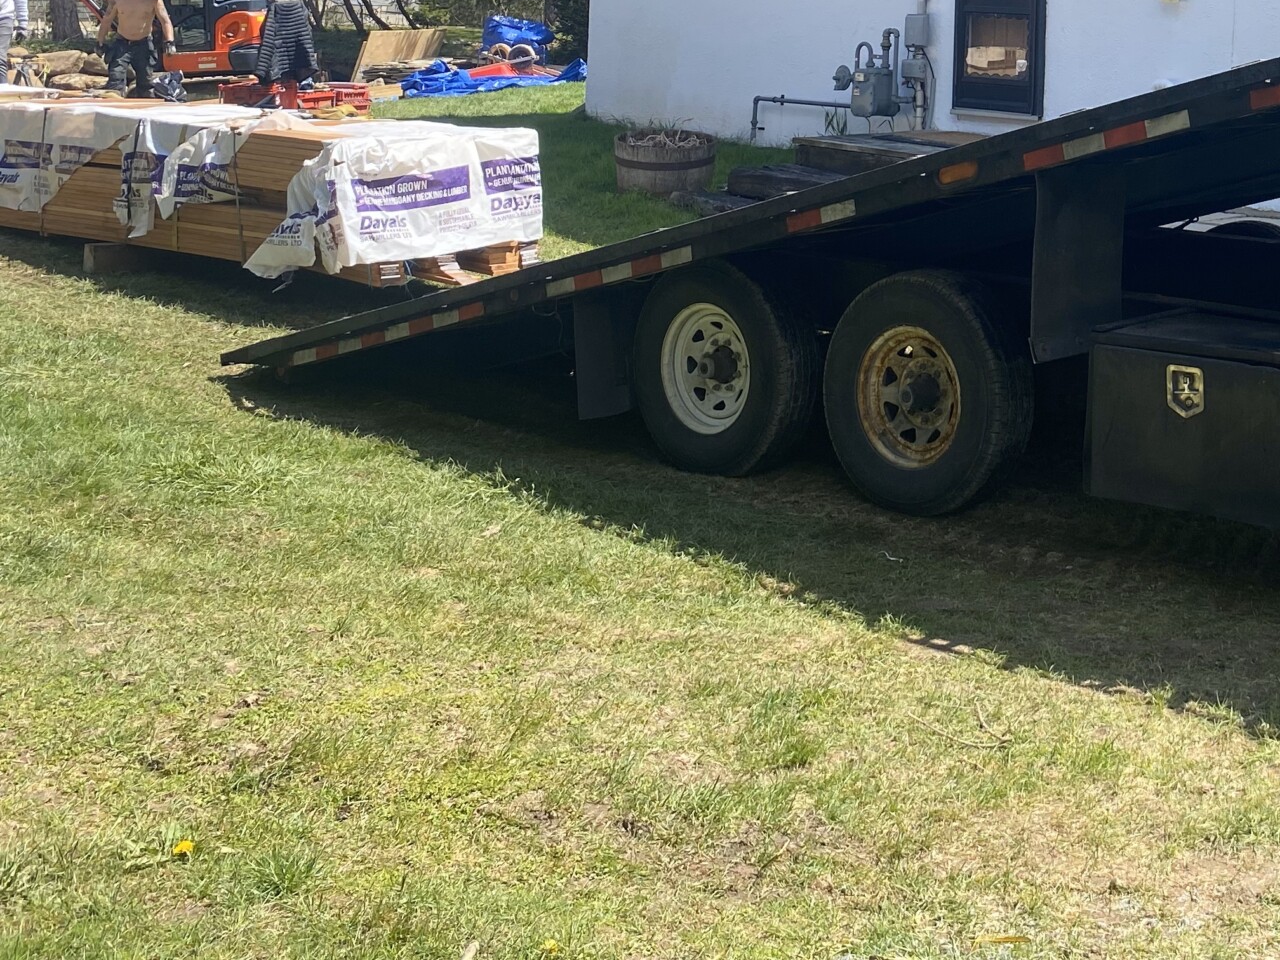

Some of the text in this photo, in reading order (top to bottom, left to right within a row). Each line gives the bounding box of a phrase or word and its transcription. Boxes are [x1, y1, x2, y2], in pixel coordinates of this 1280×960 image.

[355, 180, 428, 196] PLAATION GROWN
[416, 189, 443, 202] DECKING
[360, 215, 407, 232] Dayals
[290, 239, 302, 247] LTD
